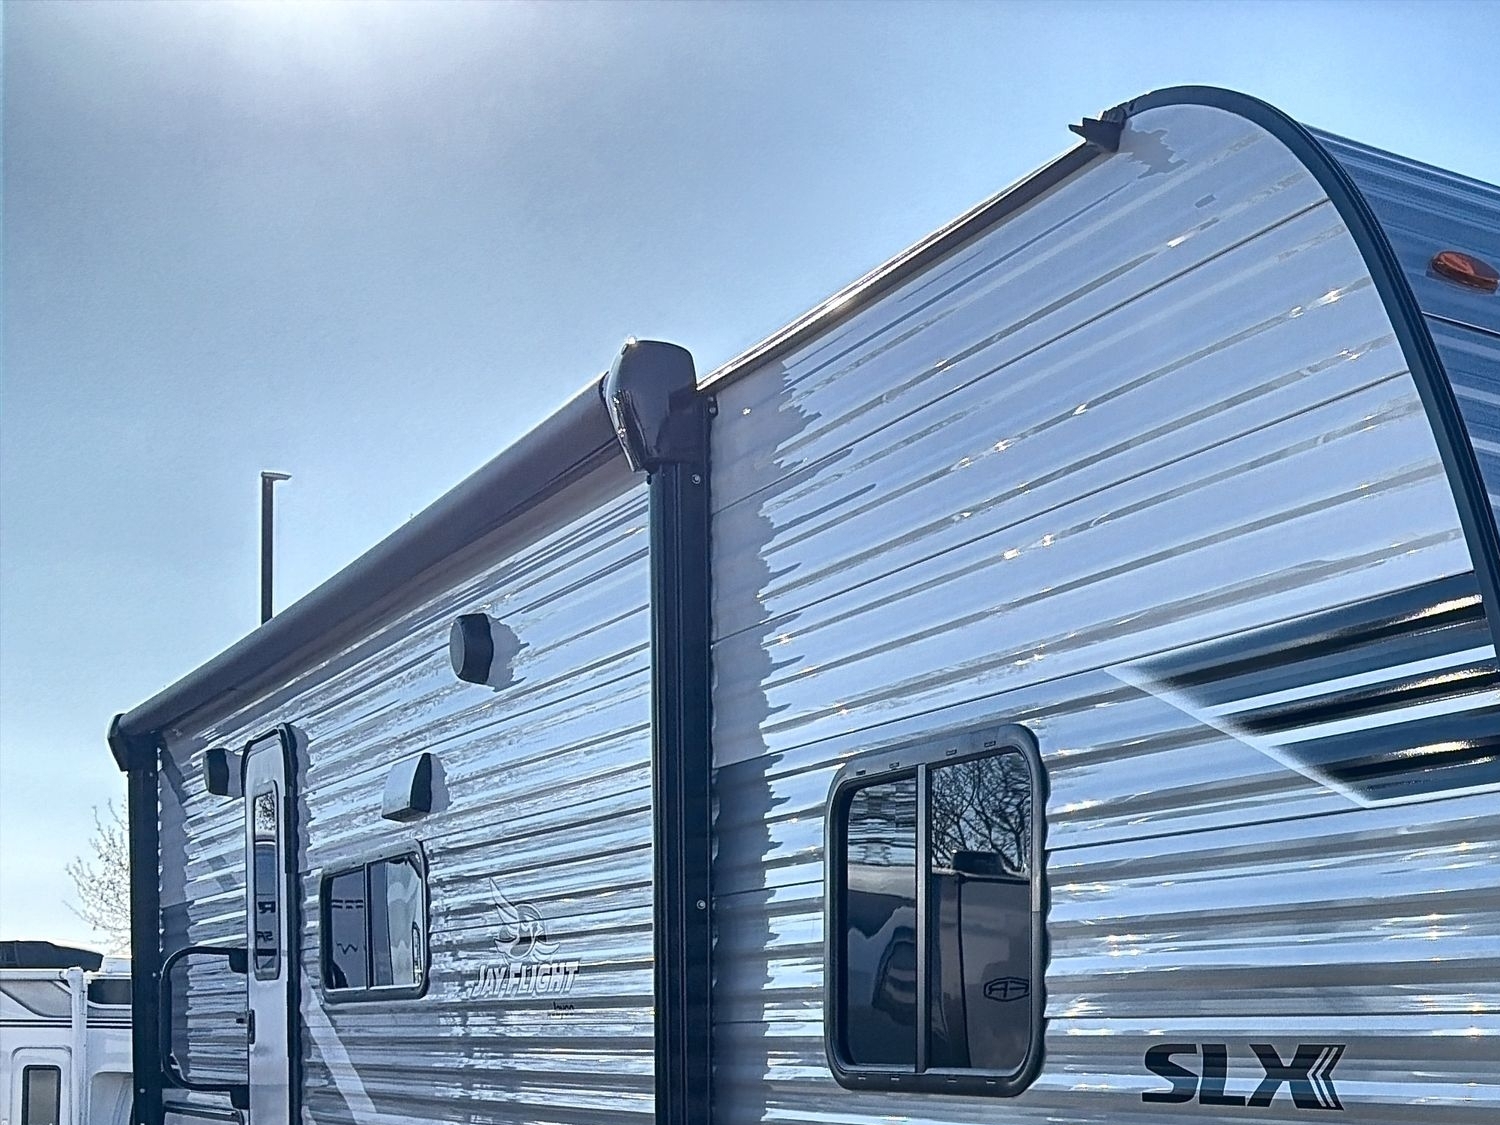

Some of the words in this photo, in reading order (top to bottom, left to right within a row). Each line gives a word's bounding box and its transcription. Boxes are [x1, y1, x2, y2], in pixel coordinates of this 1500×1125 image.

[471, 964, 507, 997] JAY
[506, 961, 580, 995] FLIGHT
[1141, 1043, 1347, 1111] SLX
